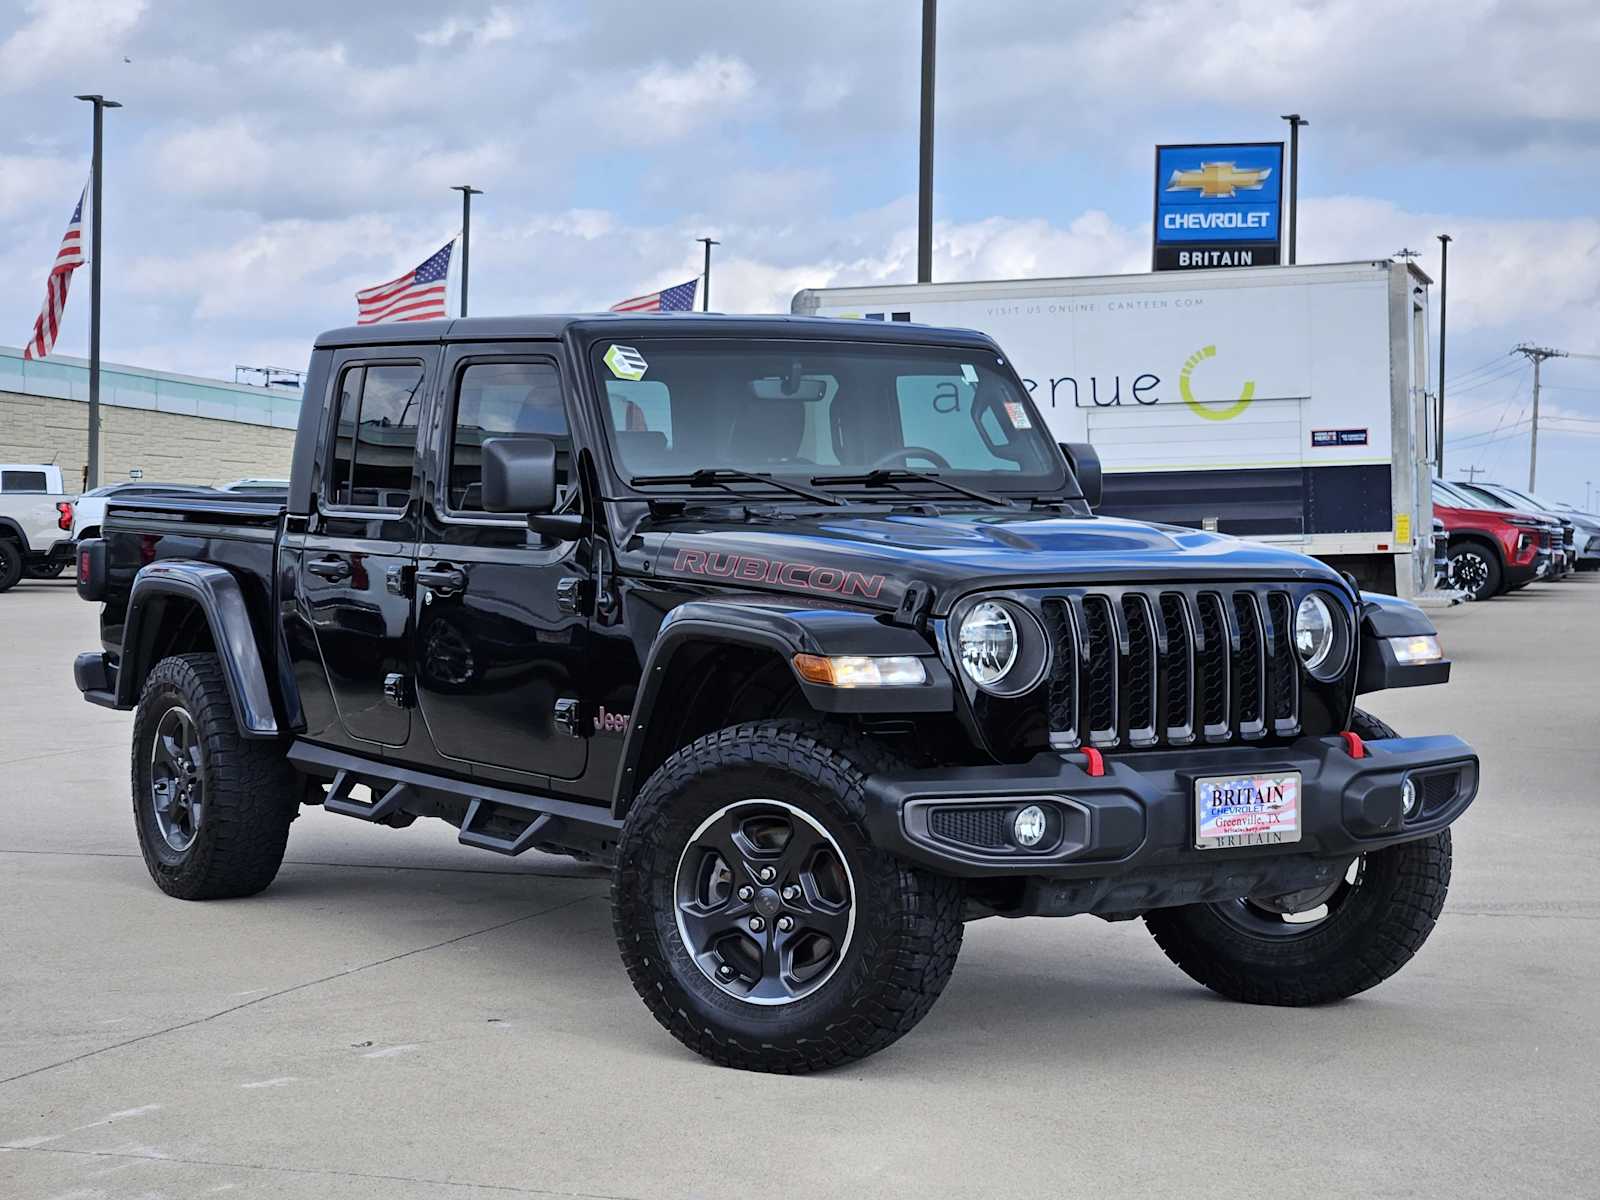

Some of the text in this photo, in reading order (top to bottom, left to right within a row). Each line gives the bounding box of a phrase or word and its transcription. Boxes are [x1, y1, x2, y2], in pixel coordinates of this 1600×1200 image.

[1164, 212, 1270, 229] CHEVROLET
[1179, 251, 1252, 266] BRITAIN
[986, 304, 1020, 316] VISIT
[1026, 303, 1041, 315] US
[932, 373, 1161, 414] anue
[673, 548, 886, 599] RUBICON
[1212, 785, 1284, 807] BRITAIN
[1211, 804, 1265, 816] CHEVROLET
[1215, 813, 1280, 828] Greenville, TX
[1216, 831, 1282, 847] BRITAIN
